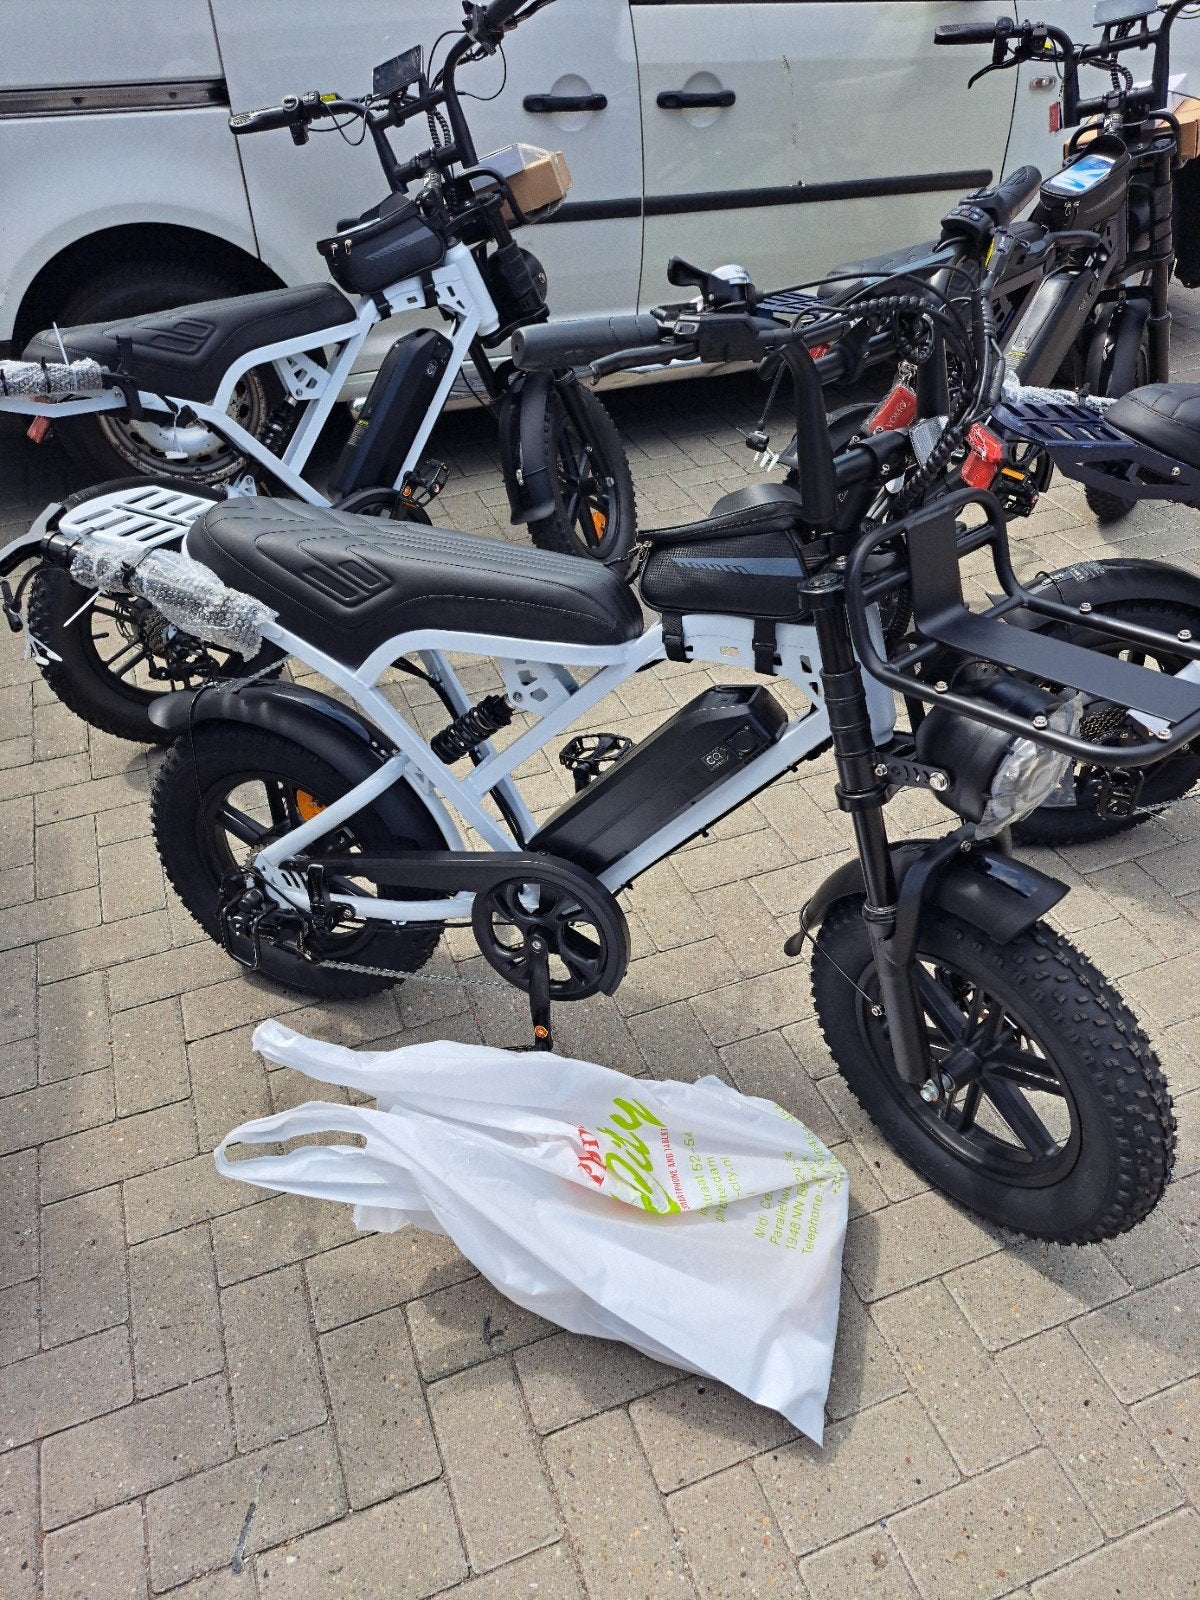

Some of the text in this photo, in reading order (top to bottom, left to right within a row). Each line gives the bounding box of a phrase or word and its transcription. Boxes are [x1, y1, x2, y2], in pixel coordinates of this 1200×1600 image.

[660, 1128, 673, 1151] TABLET
[665, 1154, 677, 1168] AND
[792, 1200, 805, 1218] NN
[785, 1221, 802, 1249] 1948
